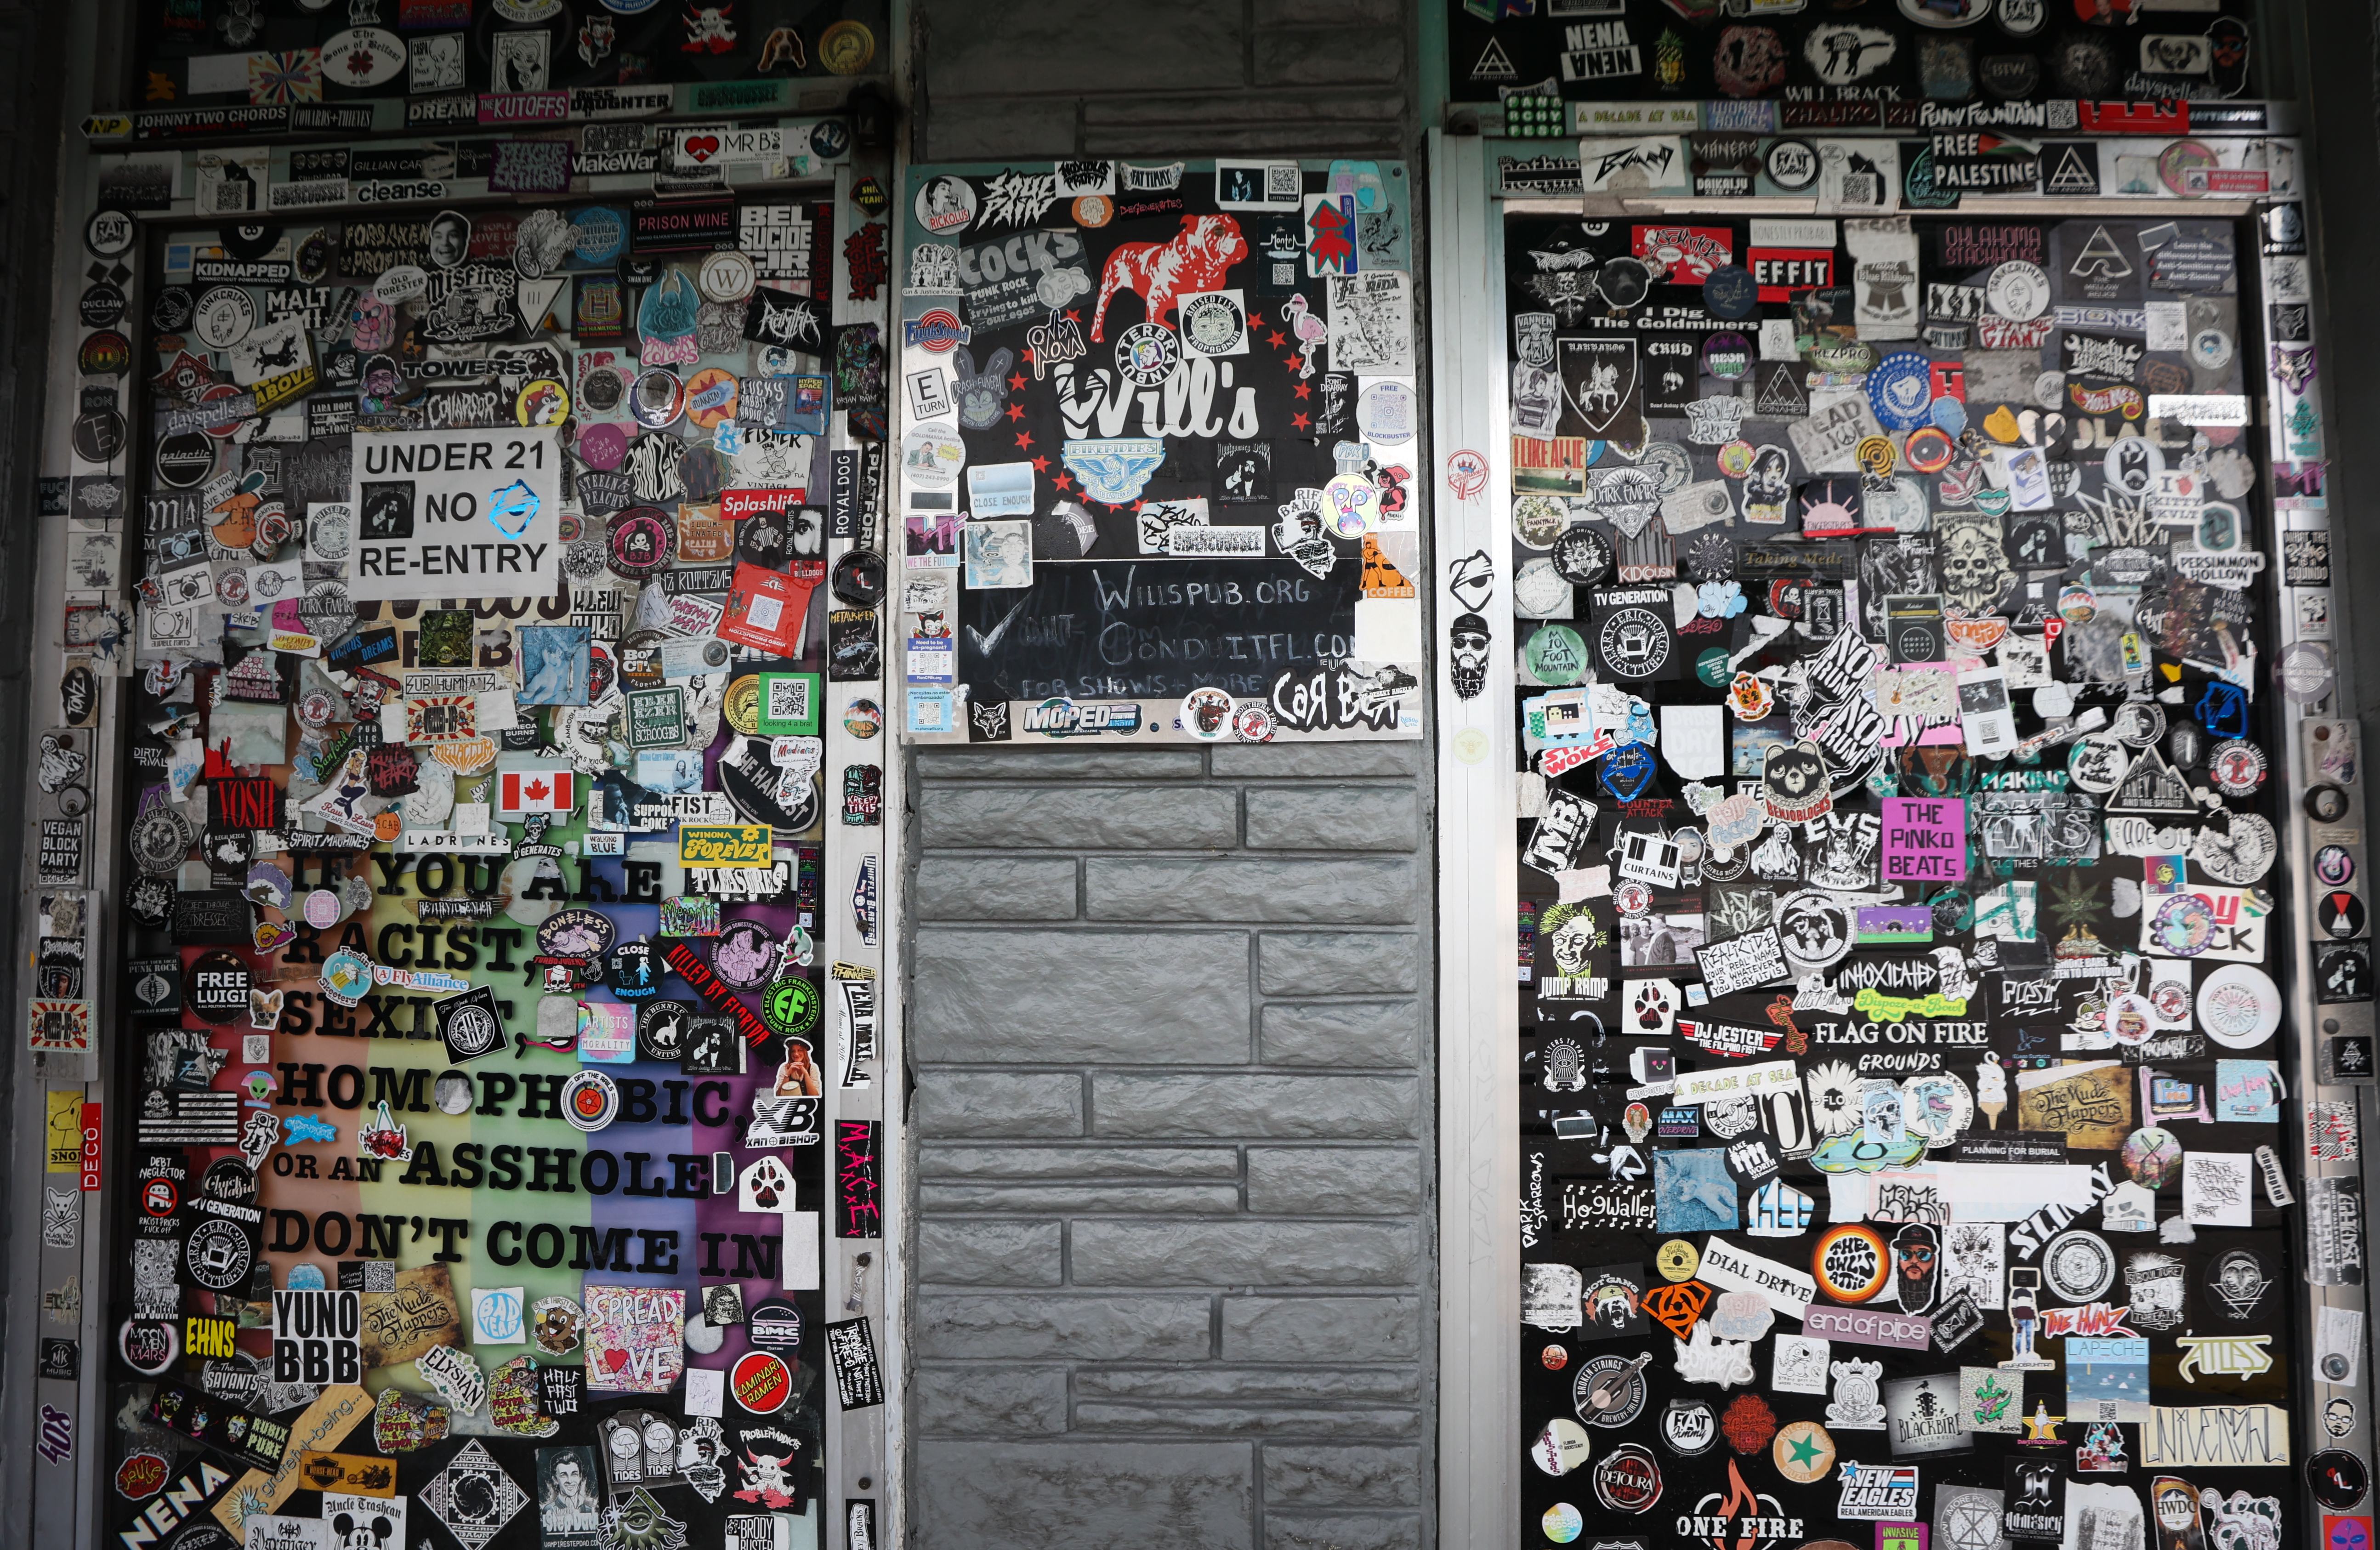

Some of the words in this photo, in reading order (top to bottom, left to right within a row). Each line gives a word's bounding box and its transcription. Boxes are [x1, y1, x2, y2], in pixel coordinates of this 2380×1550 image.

[1565, 21, 1629, 49] NENA
[137, 113, 192, 128] JOHNNY
[194, 111, 224, 124] TWO
[229, 107, 286, 122] CHORDS
[412, 102, 476, 120] DREAM
[480, 99, 494, 111] THE
[494, 96, 566, 118] KUTOFFS
[1933, 134, 1979, 156] FREE
[572, 153, 658, 174] MakeWar
[1935, 162, 2036, 186] PALESTINE
[358, 182, 442, 202] cleanse
[639, 215, 688, 231] PRISON
[694, 213, 728, 227] WINE
[931, 209, 969, 230] RICKOLUS
[1946, 227, 2041, 245] OKLAHOMA
[1946, 245, 2042, 265] STACKHOUSE
[196, 263, 290, 278] KIDNAPPED
[1755, 261, 1827, 285] EFFIT
[267, 286, 330, 312] MALT
[971, 284, 1000, 302] PUNK
[1002, 277, 1031, 293] ROCK
[970, 298, 1006, 322] trying
[1007, 301, 1018, 311] to
[1021, 293, 1038, 306] kill
[986, 314, 1008, 326] our
[1005, 306, 1035, 320] egos
[1646, 307, 1653, 317] I
[1664, 307, 1704, 319] Dig
[1590, 317, 1630, 328] The
[1637, 318, 1758, 330] Goldminers
[1054, 354, 1259, 439] Will's
[160, 449, 212, 462] galactic
[366, 443, 492, 474] UNDER
[505, 441, 542, 469] 21
[1514, 438, 1519, 467] I
[1522, 437, 1551, 467] LIKE
[1555, 437, 1584, 468] ALLIE
[426, 493, 477, 522] NO
[724, 495, 803, 512] Splashlife
[360, 544, 547, 576] RE-ENTRY
[907, 557, 918, 567] WE
[919, 557, 931, 567] THE
[934, 556, 960, 566] FUTURE
[2181, 558, 2258, 569] PERSIMMON
[2191, 568, 2248, 581] HOLLOW
[1369, 587, 1413, 597] COFFEE
[1595, 593, 1608, 606] TV
[1612, 591, 1667, 605] GENERATION
[1022, 679, 1063, 697] FOR
[1079, 676, 1166, 696] SHOWS
[1192, 674, 1262, 692] MORE
[1024, 706, 1111, 730] MOPED
[1982, 771, 2069, 789] MAKING
[1618, 799, 1674, 810] COUNTER
[1625, 808, 1664, 818] ATTACK
[1766, 796, 1830, 822] BENJOBLOCKS
[1902, 803, 1943, 824] THE
[44, 822, 81, 835] VEGAN
[688, 831, 732, 839] WINONA
[1892, 829, 1954, 849] PINKO
[43, 837, 78, 851] BLOCK
[687, 840, 768, 861] FOREVER
[41, 852, 78, 866] PARTY
[1889, 856, 1956, 876] BEATS
[286, 850, 352, 892] IF
[370, 852, 506, 896] YOU
[1624, 863, 1674, 884] CURTAINS
[279, 920, 538, 985] RACIST,
[618, 946, 649, 955] CLOSE
[198, 972, 247, 988] FREE
[1539, 977, 1572, 997] JUMP
[1574, 977, 1607, 997] RAMP
[198, 989, 247, 1003] LUIGI
[615, 987, 655, 996] ENOUGH
[280, 990, 527, 1059] SEXI,
[1694, 1023, 1709, 1040] DJ
[1713, 1025, 1764, 1046] JESTER
[1815, 1021, 1879, 1043] FLAG
[1886, 1023, 1926, 1044] ON
[1933, 1023, 1988, 1044] FIRE
[276, 1062, 747, 1143] HOMPHBIC,
[84, 1118, 98, 1187] DECO.
[1962, 1146, 2006, 1156] PLANNING
[2010, 1147, 2027, 1156] FOR
[2031, 1147, 2060, 1156] BURIAL
[150, 1157, 170, 1168] DEBT
[273, 1153, 319, 1179] OR
[328, 1157, 385, 1182] AN
[398, 1141, 706, 1192] ASSHOLE
[141, 1168, 185, 1180] NEGLECTOR
[139, 1217, 159, 1225] RACIST
[160, 1217, 179, 1226] PRICKS
[487, 1221, 679, 1275] COME
[699, 1232, 783, 1279] IN
[1707, 1250, 1749, 1278] DIAL
[1755, 1274, 1812, 1304] DRIVE
[274, 1292, 358, 1338] YUNO
[2068, 1341, 2145, 1356] LAPECHE
[274, 1340, 358, 1383] BBB
[735, 1359, 779, 1398] KAMINARI
[745, 1373, 781, 1405] RAMEN
[1600, 1470, 1653, 1493] DETOURA
[1852, 1469, 1890, 1488] NEW
[1845, 1487, 1915, 1506] EAGLES
[1676, 1516, 1727, 1537] ONE
[1741, 1517, 1803, 1538] FIRE
